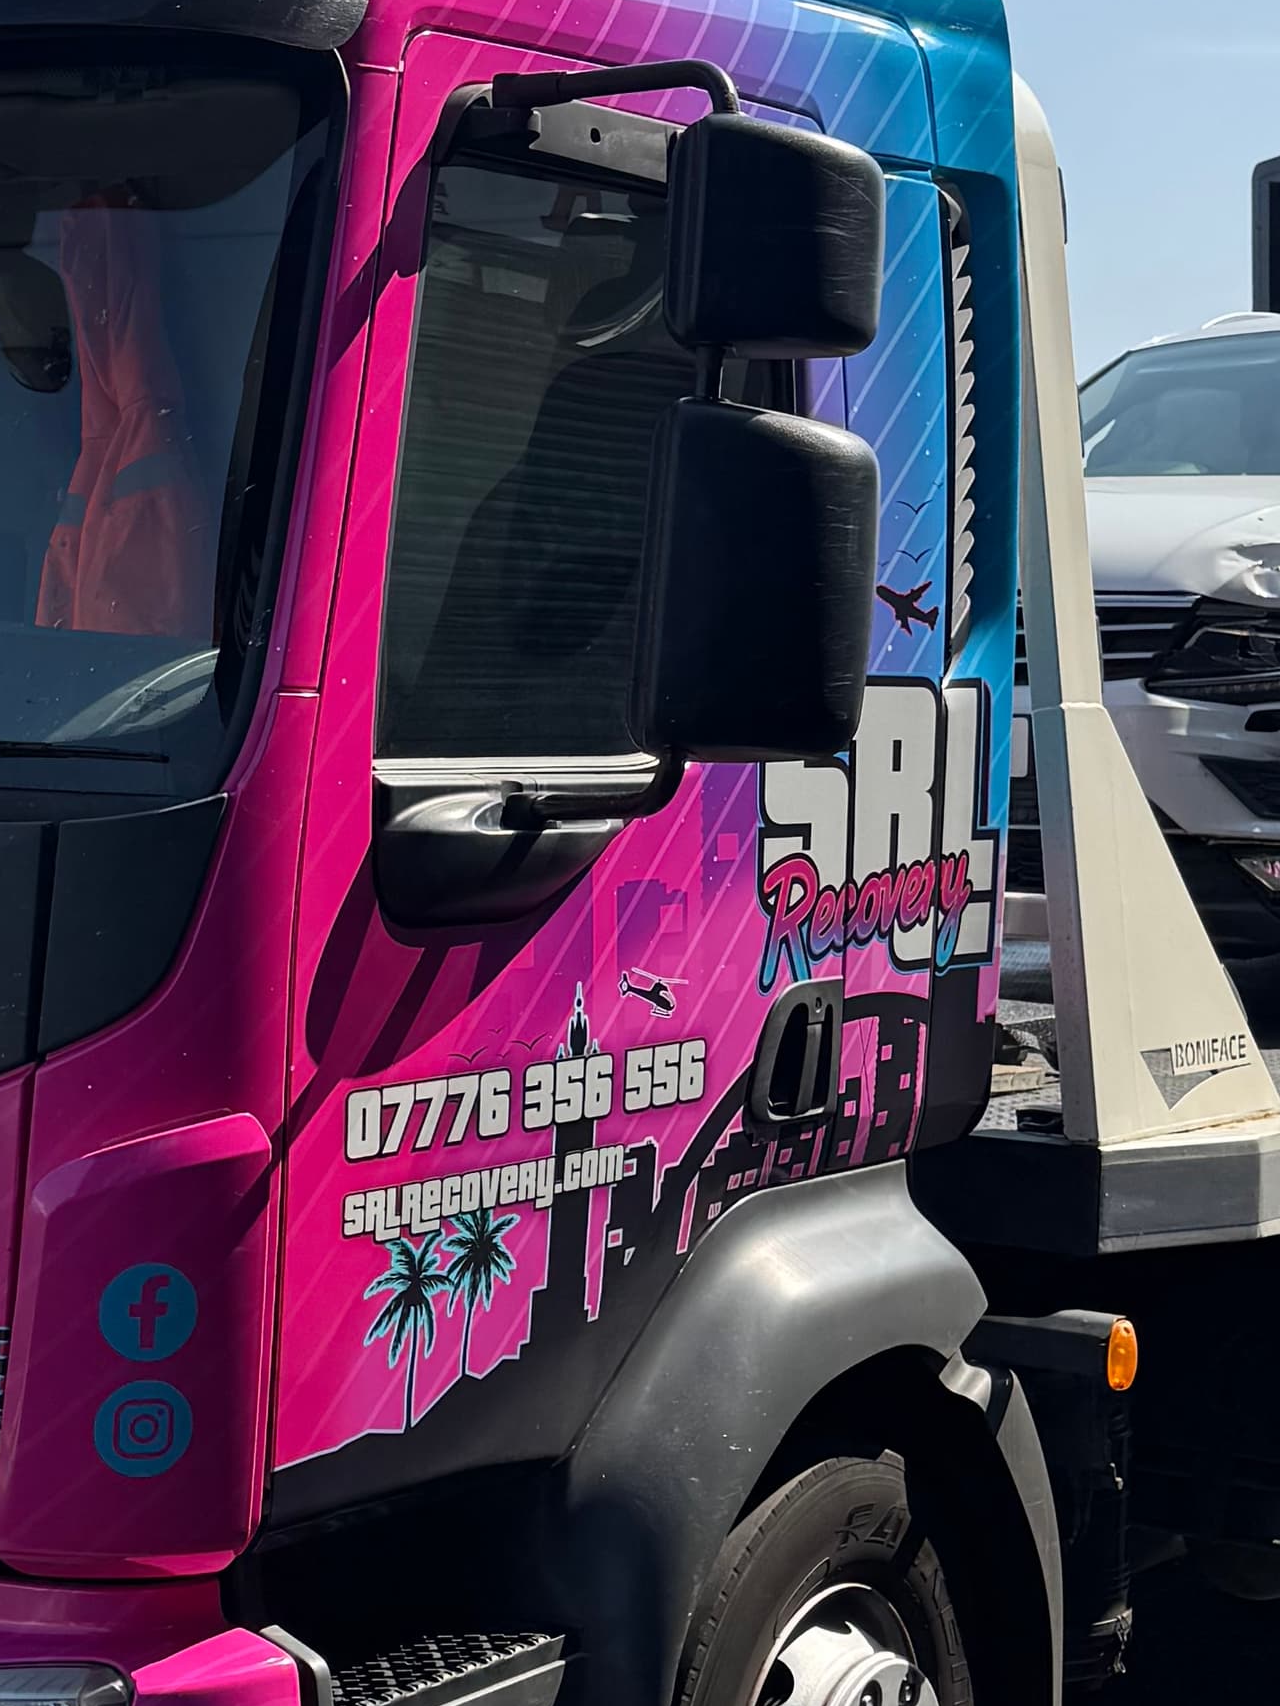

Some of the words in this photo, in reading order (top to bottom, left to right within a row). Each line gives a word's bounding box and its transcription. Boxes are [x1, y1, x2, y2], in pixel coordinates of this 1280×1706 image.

[761, 850, 972, 988] Recovery
[344, 1067, 511, 1161] 07776
[521, 1054, 613, 1130] 356
[623, 1038, 706, 1113] 556
[1174, 1033, 1248, 1068] BONIFACE
